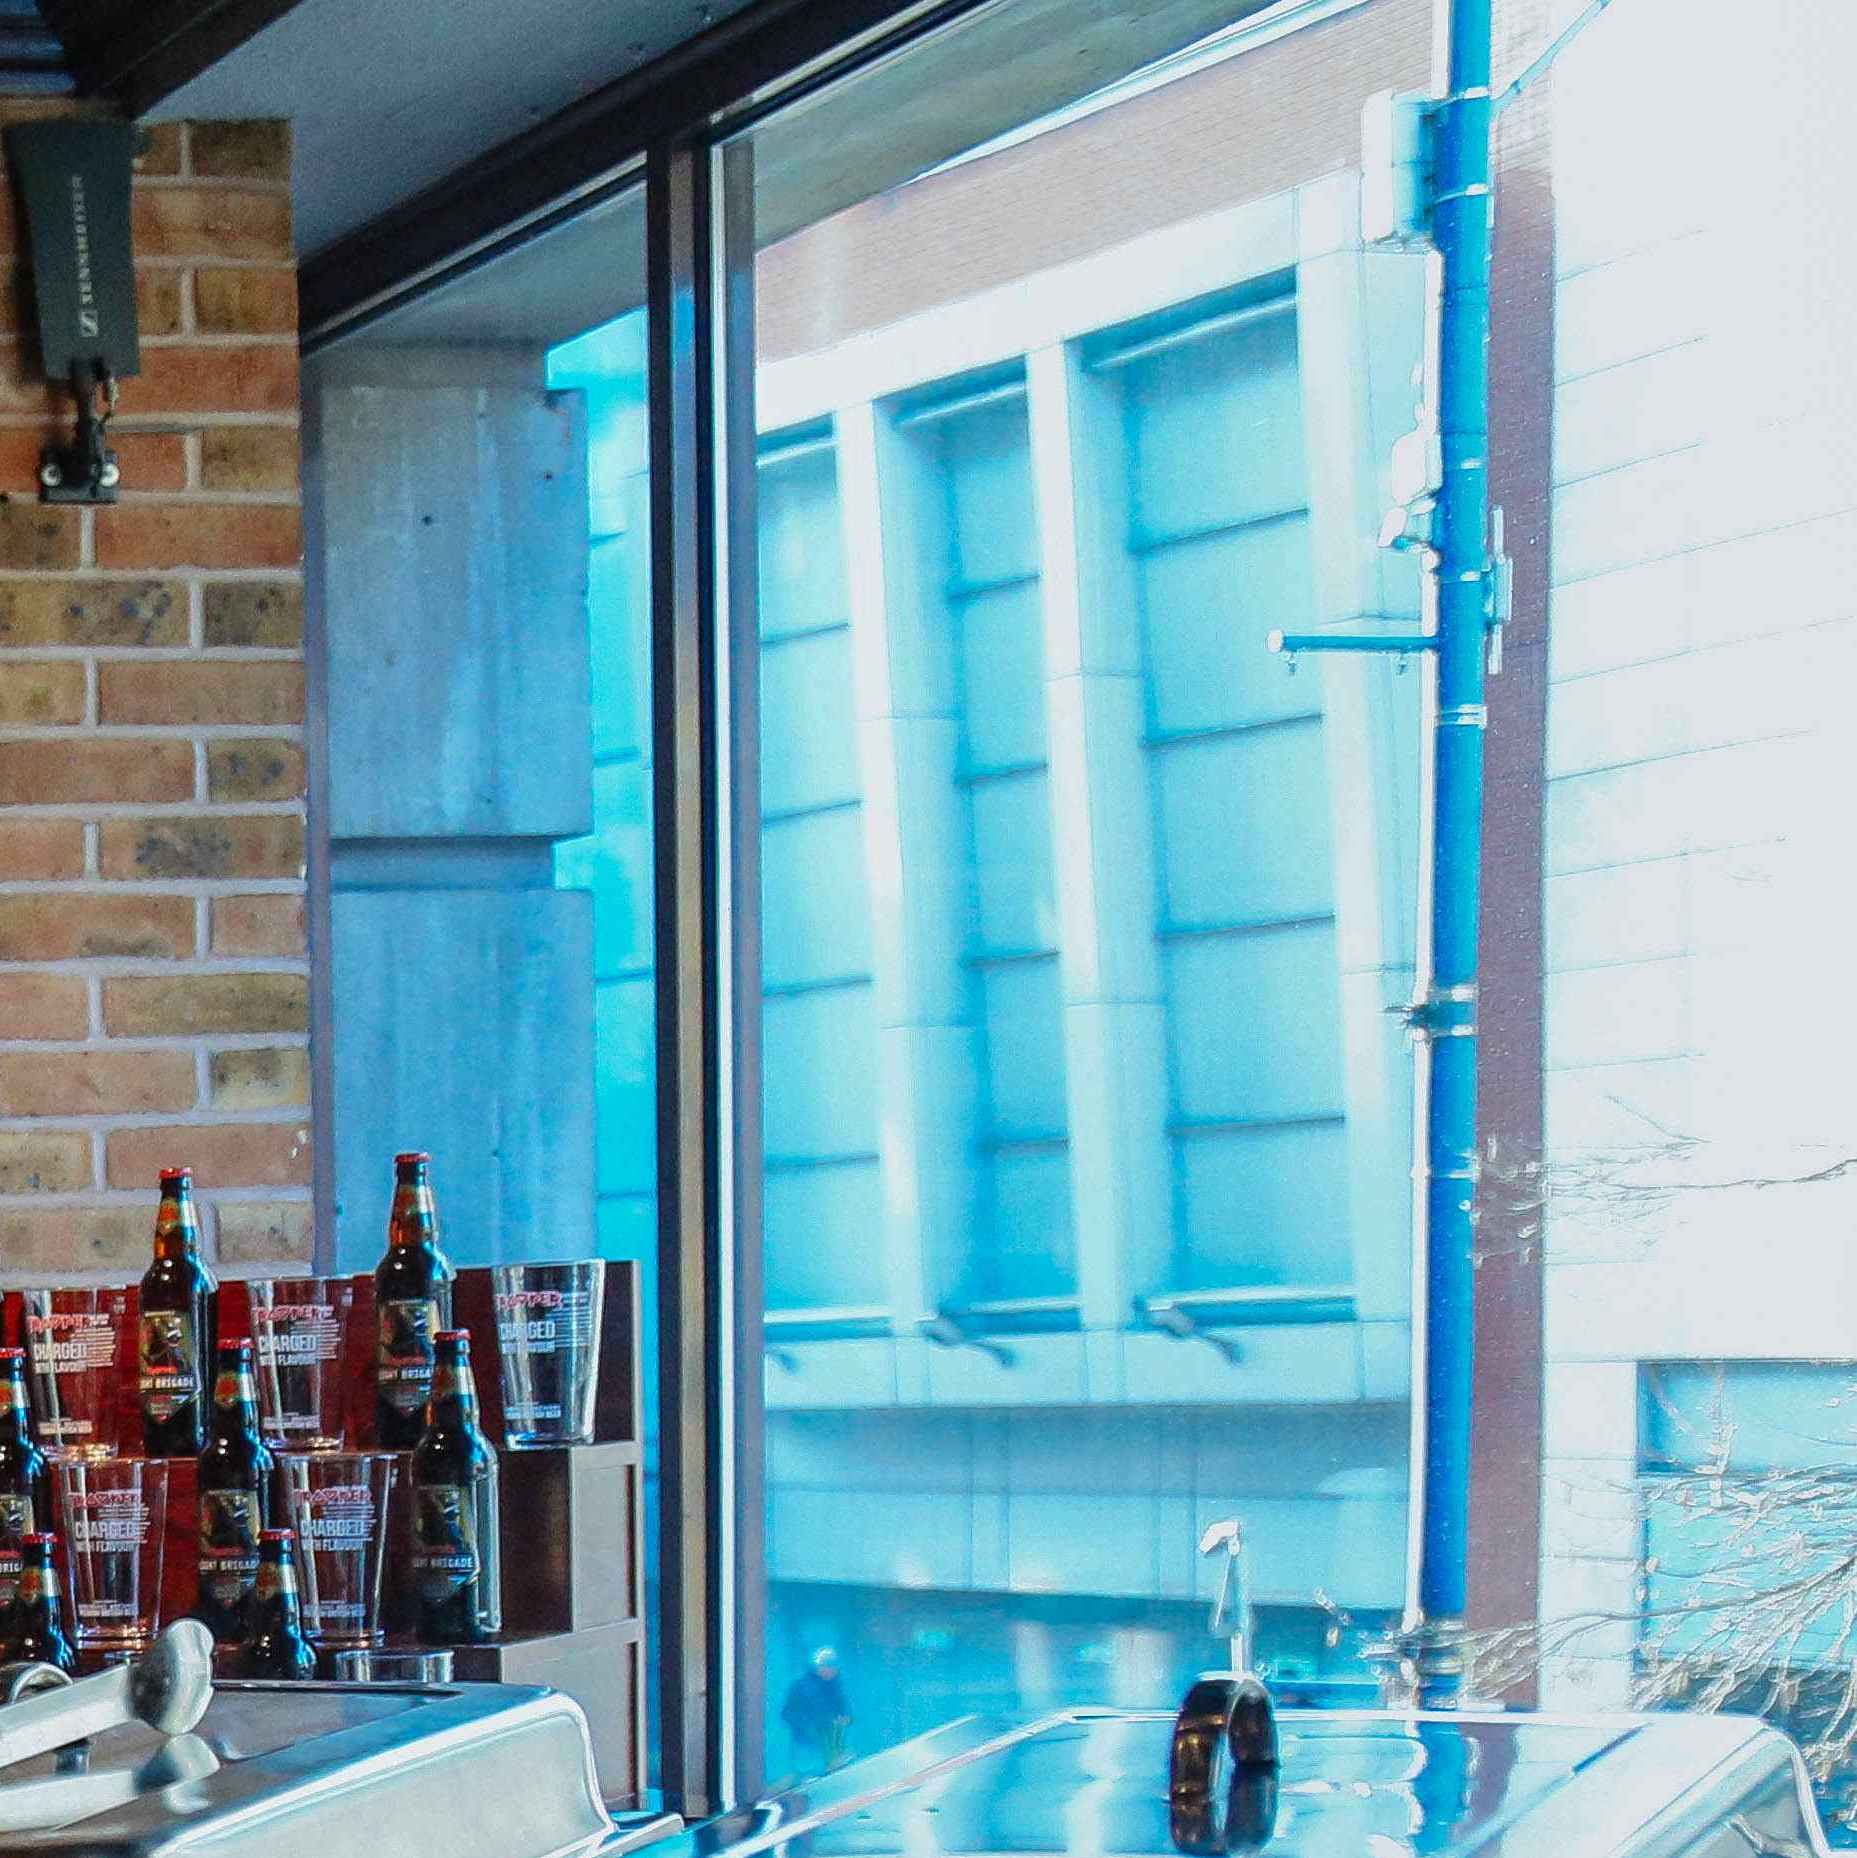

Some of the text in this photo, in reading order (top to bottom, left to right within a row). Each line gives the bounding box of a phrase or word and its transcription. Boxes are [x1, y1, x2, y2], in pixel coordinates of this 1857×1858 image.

[34, 1342, 87, 1360] CHARGED
[259, 1335, 317, 1352] CHARGED
[156, 1375, 194, 1388] BRIGADE
[75, 1520, 136, 1539] CHARGED
[300, 1519, 364, 1537] CHARGED
